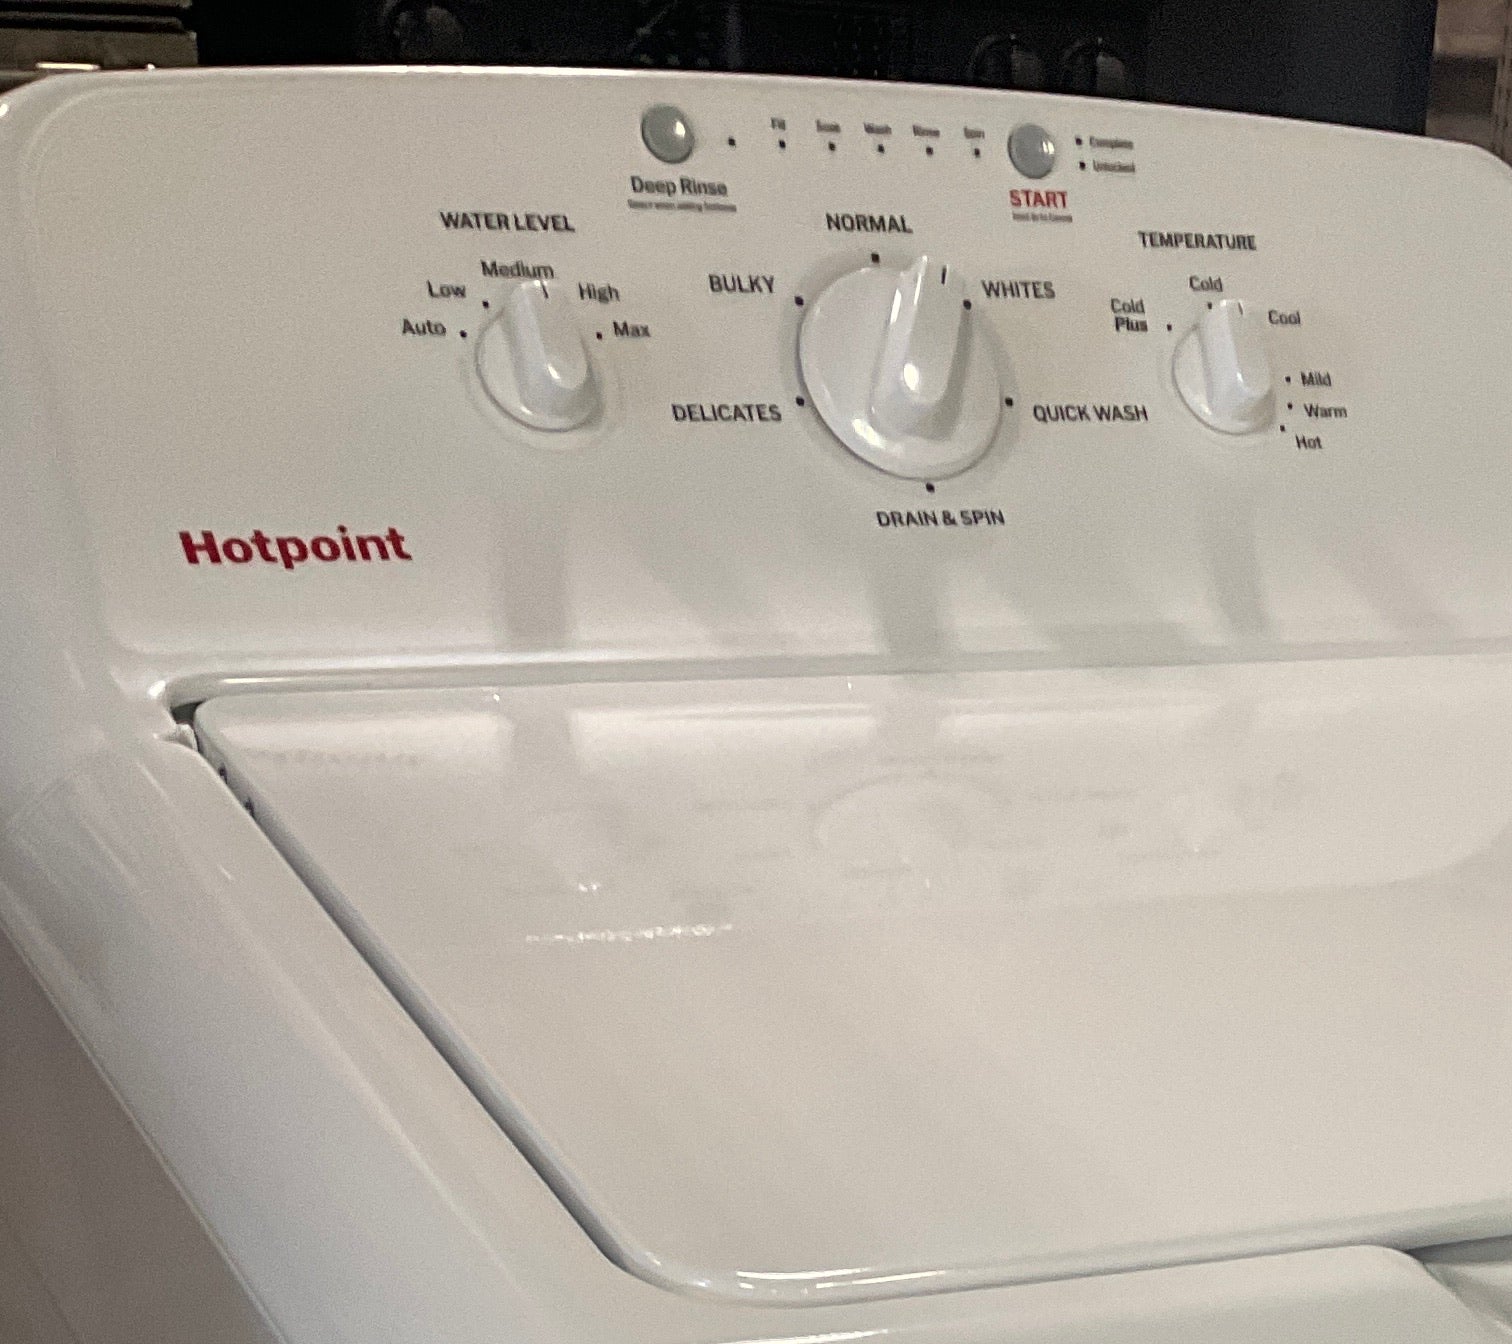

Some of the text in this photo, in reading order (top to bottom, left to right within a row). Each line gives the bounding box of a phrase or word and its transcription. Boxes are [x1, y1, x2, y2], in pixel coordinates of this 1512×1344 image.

[630, 175, 729, 196] Deep Rinse
[1009, 189, 1068, 208] START
[440, 211, 576, 233] WATER LEVEL
[826, 213, 913, 234] NORMAL
[1138, 230, 1257, 251] TEMPERATURE
[480, 259, 554, 279] Medium
[427, 280, 467, 298] Low
[579, 281, 621, 303] High
[708, 274, 775, 294] BULKY
[981, 279, 1056, 299] WHITES
[1189, 275, 1224, 292] Cold
[1110, 298, 1145, 314] Cold
[402, 318, 447, 336] Auto
[1115, 316, 1148, 332] Plus
[1268, 309, 1301, 326] Cool
[613, 320, 651, 338] Max
[1301, 371, 1332, 387] Mild
[671, 403, 782, 422] DELICATES
[1033, 404, 1149, 423] QUICK WASH
[1304, 403, 1347, 419] Warm
[1295, 435, 1323, 450] Hot
[876, 509, 1006, 528] DRAIN & SPIN
[179, 524, 413, 570] Hotpoint
